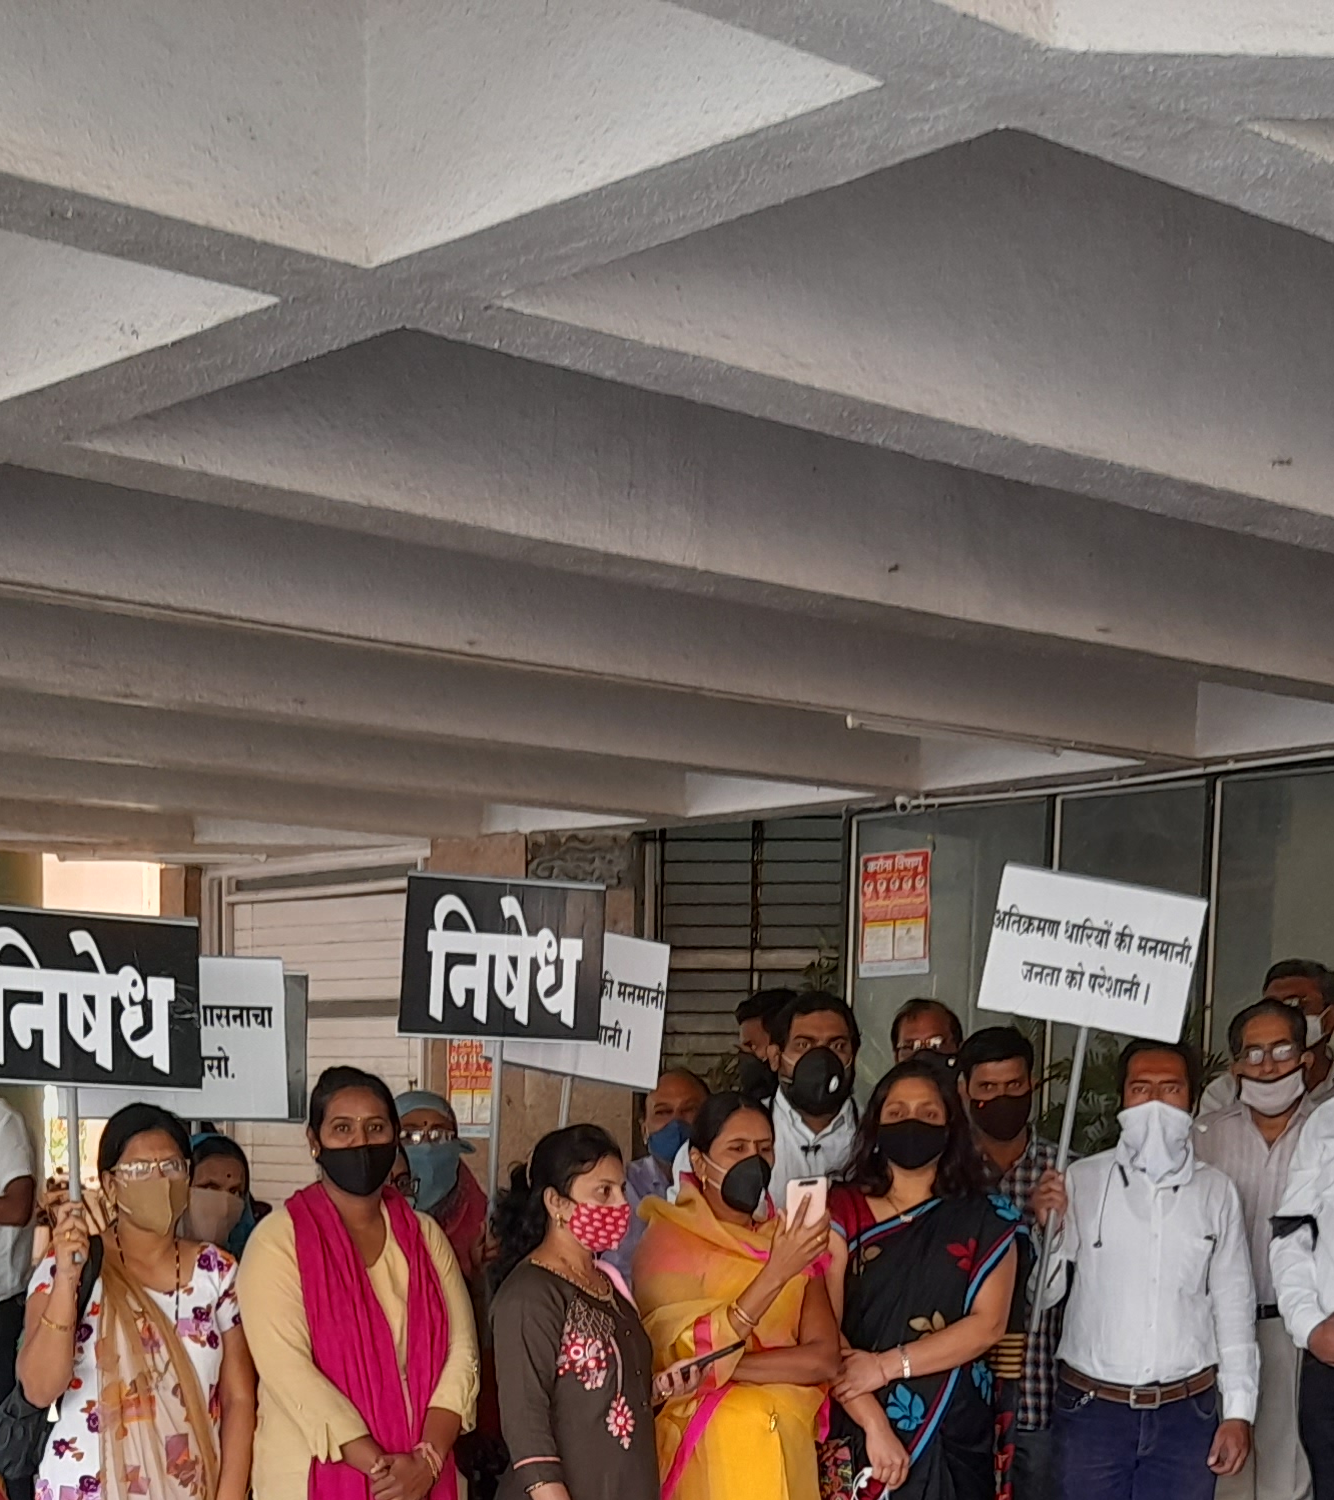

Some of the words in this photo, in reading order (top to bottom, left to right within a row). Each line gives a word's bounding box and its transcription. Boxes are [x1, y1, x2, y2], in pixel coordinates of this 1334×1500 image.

[993, 904, 1061, 940] अतिक्रमण
[1065, 917, 1112, 949] धारियों
[1115, 925, 1134, 954] की
[427, 893, 583, 1029] निषेध
[1021, 961, 1062, 988] जनता
[1065, 962, 1085, 991] को
[1088, 966, 1141, 1001] परेशानी
